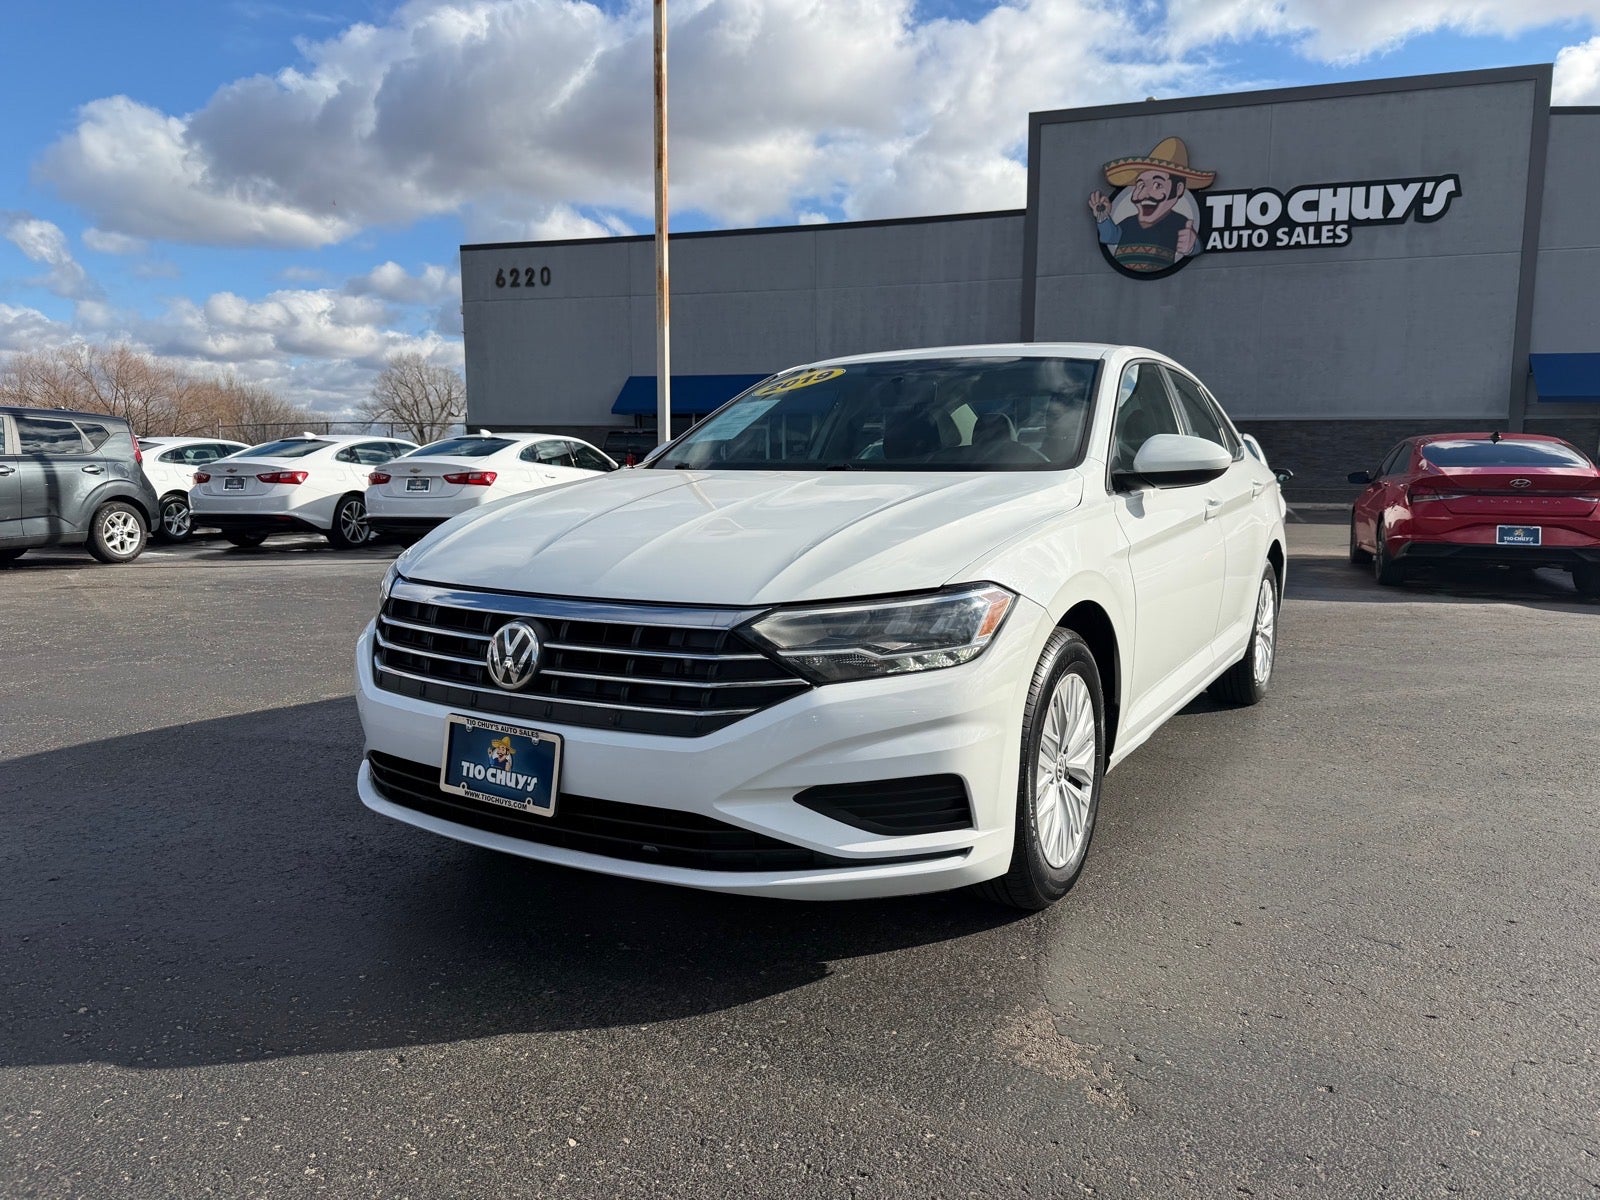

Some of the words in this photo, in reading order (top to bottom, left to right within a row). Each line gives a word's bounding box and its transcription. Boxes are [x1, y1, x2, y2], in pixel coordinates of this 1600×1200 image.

[1206, 191, 1282, 228] TIO
[1287, 179, 1456, 223] CHUY'S
[1206, 229, 1269, 250] AUTO
[1276, 224, 1348, 246] SALES
[495, 266, 551, 289] 6220
[761, 370, 834, 394] 2019
[477, 721, 500, 731] CHUY'S
[500, 726, 518, 734] AUTO
[518, 730, 539, 739] SALES
[461, 761, 486, 779] TIO
[486, 767, 538, 792] CHUY'S
[464, 789, 528, 810] WWW.TIOCHUYS.COM
